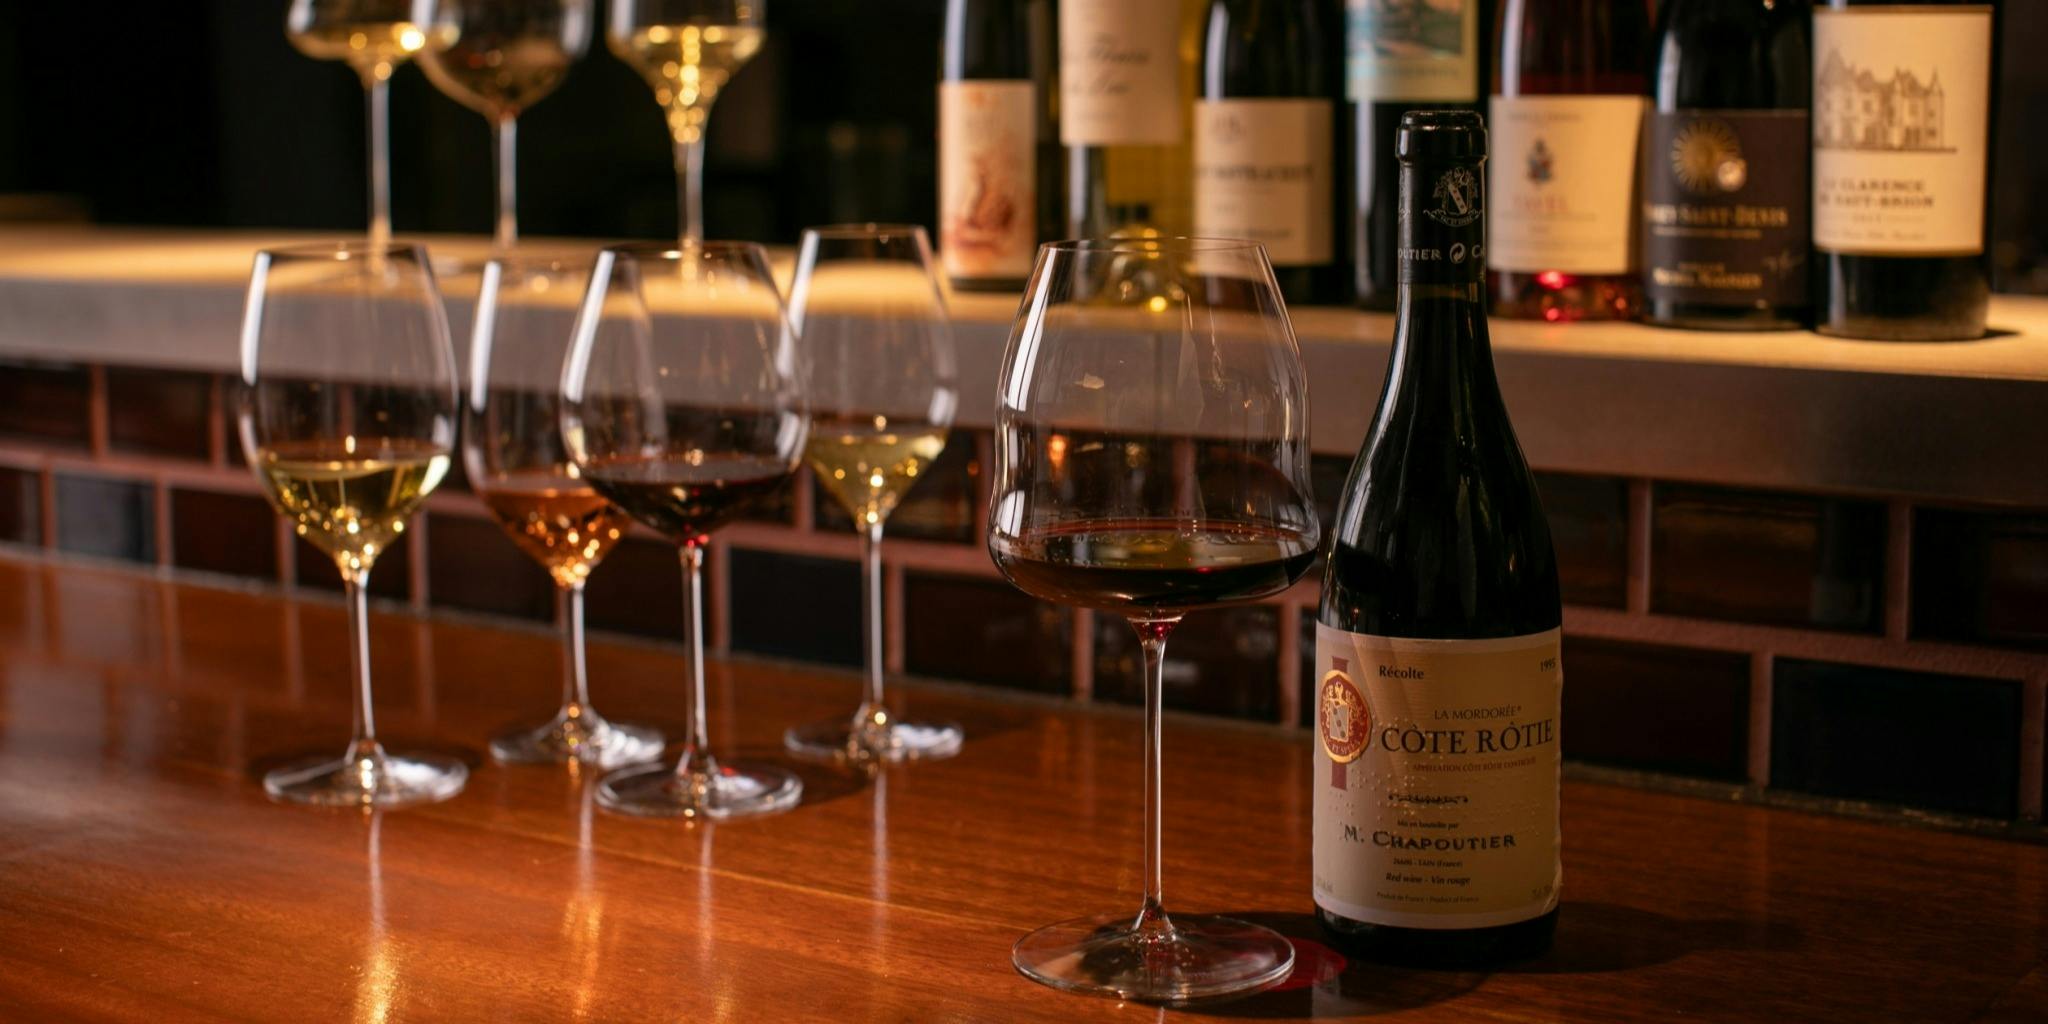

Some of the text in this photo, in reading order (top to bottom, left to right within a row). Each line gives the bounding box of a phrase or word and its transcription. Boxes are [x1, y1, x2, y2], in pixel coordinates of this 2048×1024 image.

[1379, 665, 1425, 680] Récolte
[1434, 709, 1449, 720] LA
[1381, 722, 1467, 754] CÔTE
[1477, 718, 1554, 753] RÔTIE
[1344, 825, 1517, 851] M. CHAPOUTIER
[1385, 872, 1401, 882] Red
[1431, 874, 1446, 884] Vin
[1447, 876, 1471, 886] rouge
